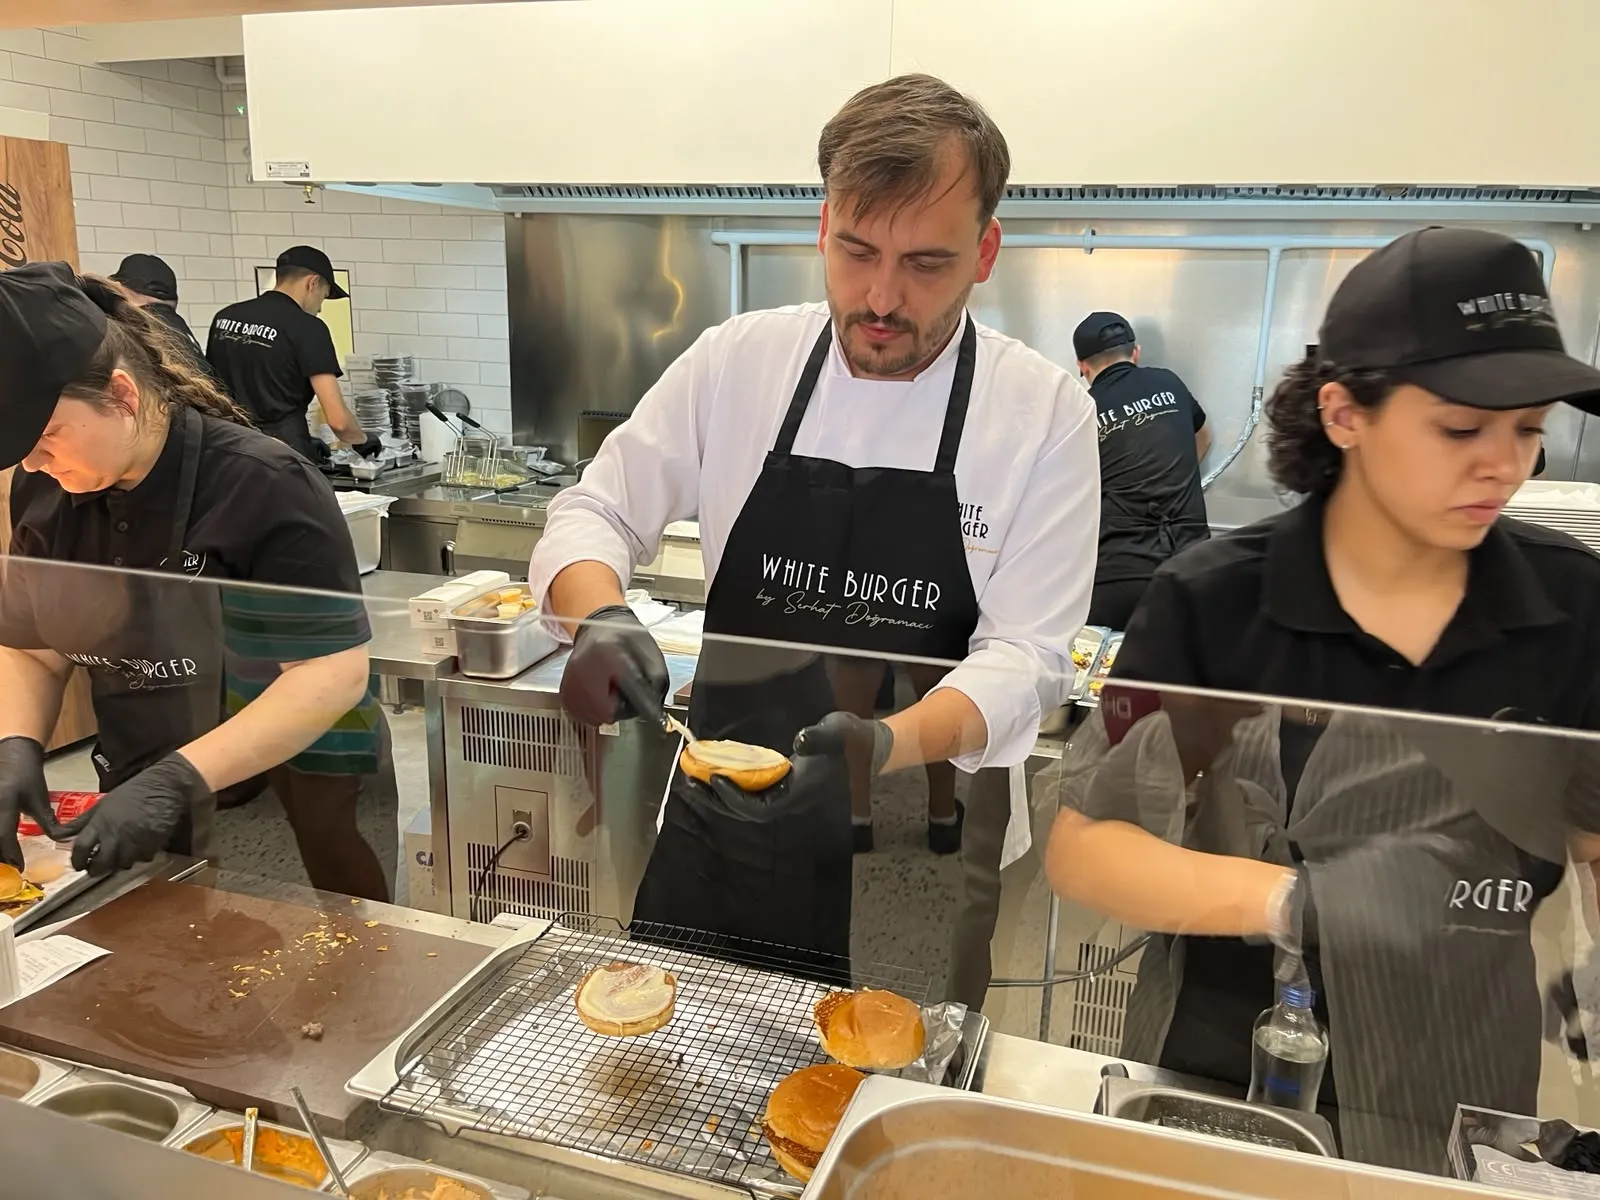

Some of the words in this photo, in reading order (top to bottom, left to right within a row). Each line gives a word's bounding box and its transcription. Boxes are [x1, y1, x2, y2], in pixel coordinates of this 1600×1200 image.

[1122, 391, 1177, 417] BURGER
[957, 502, 983, 521] HITE
[762, 553, 829, 594] WHITE
[843, 570, 941, 611] BURGER
[755, 588, 776, 606] by
[783, 590, 842, 621] Serhat
